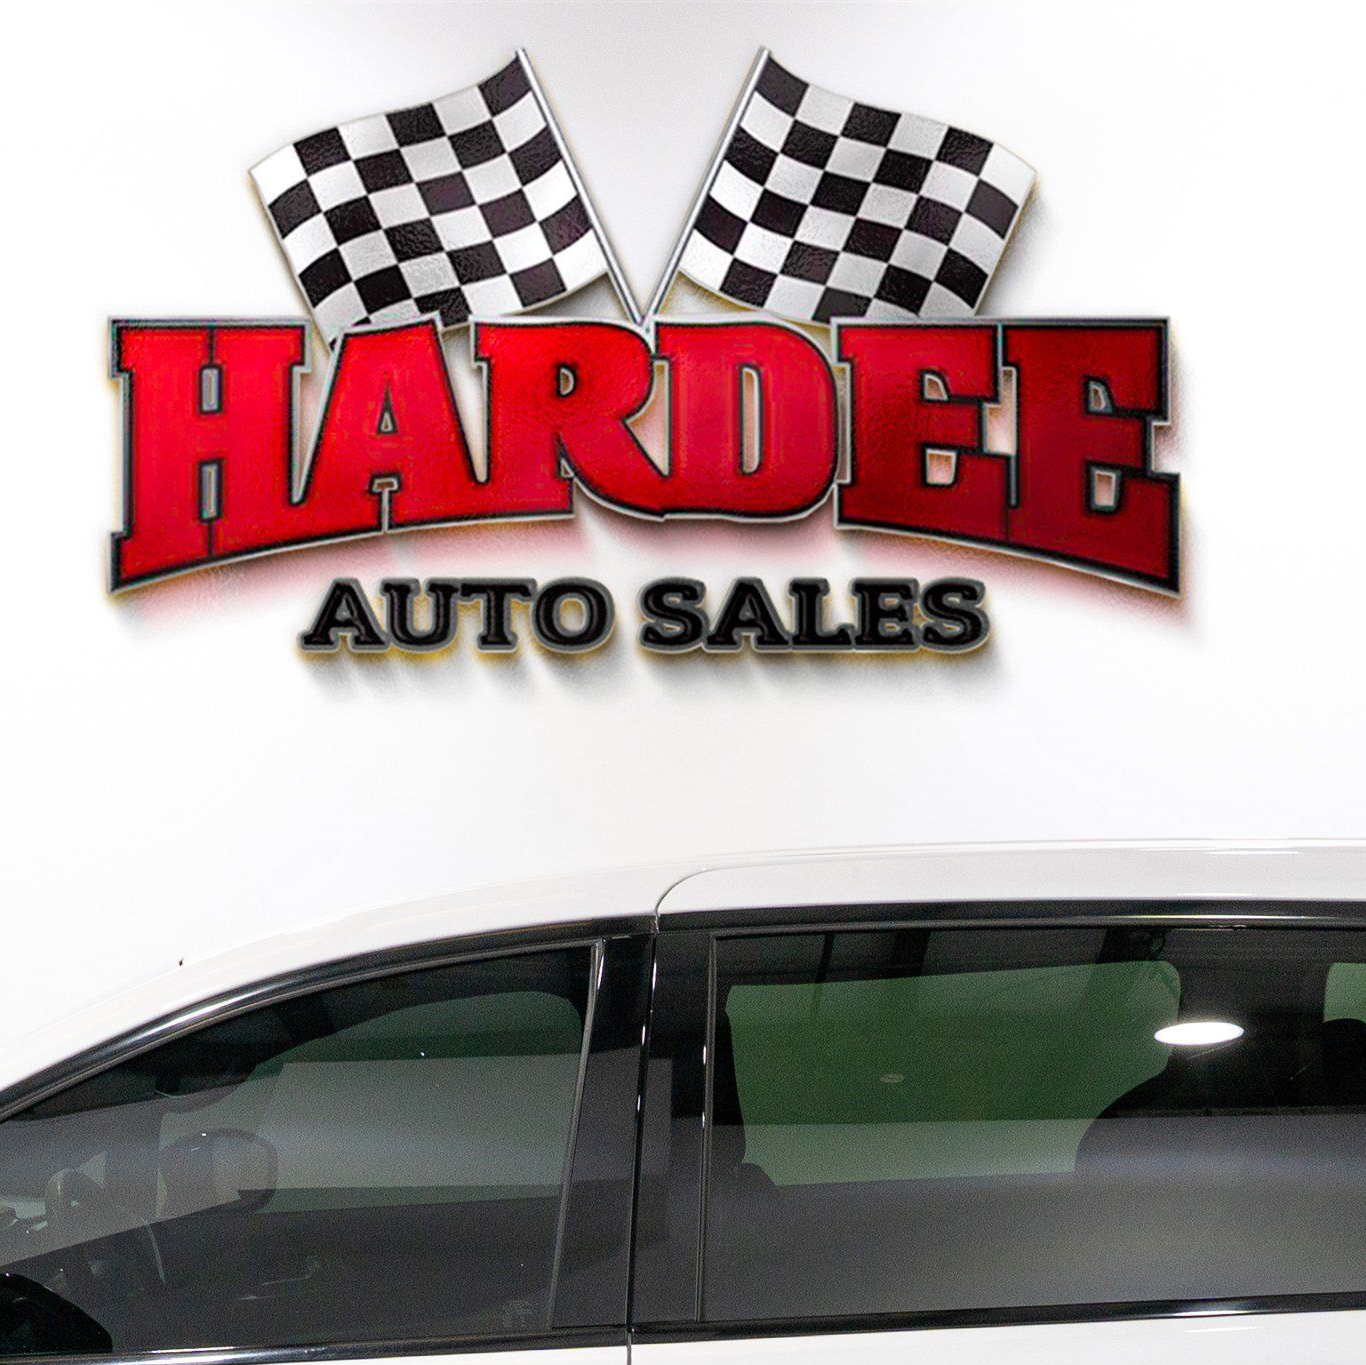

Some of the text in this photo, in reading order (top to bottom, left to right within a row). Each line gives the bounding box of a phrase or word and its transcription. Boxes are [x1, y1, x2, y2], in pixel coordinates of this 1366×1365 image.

[107, 314, 1182, 597] HARDEE
[297, 576, 990, 654] AUTO SALES
